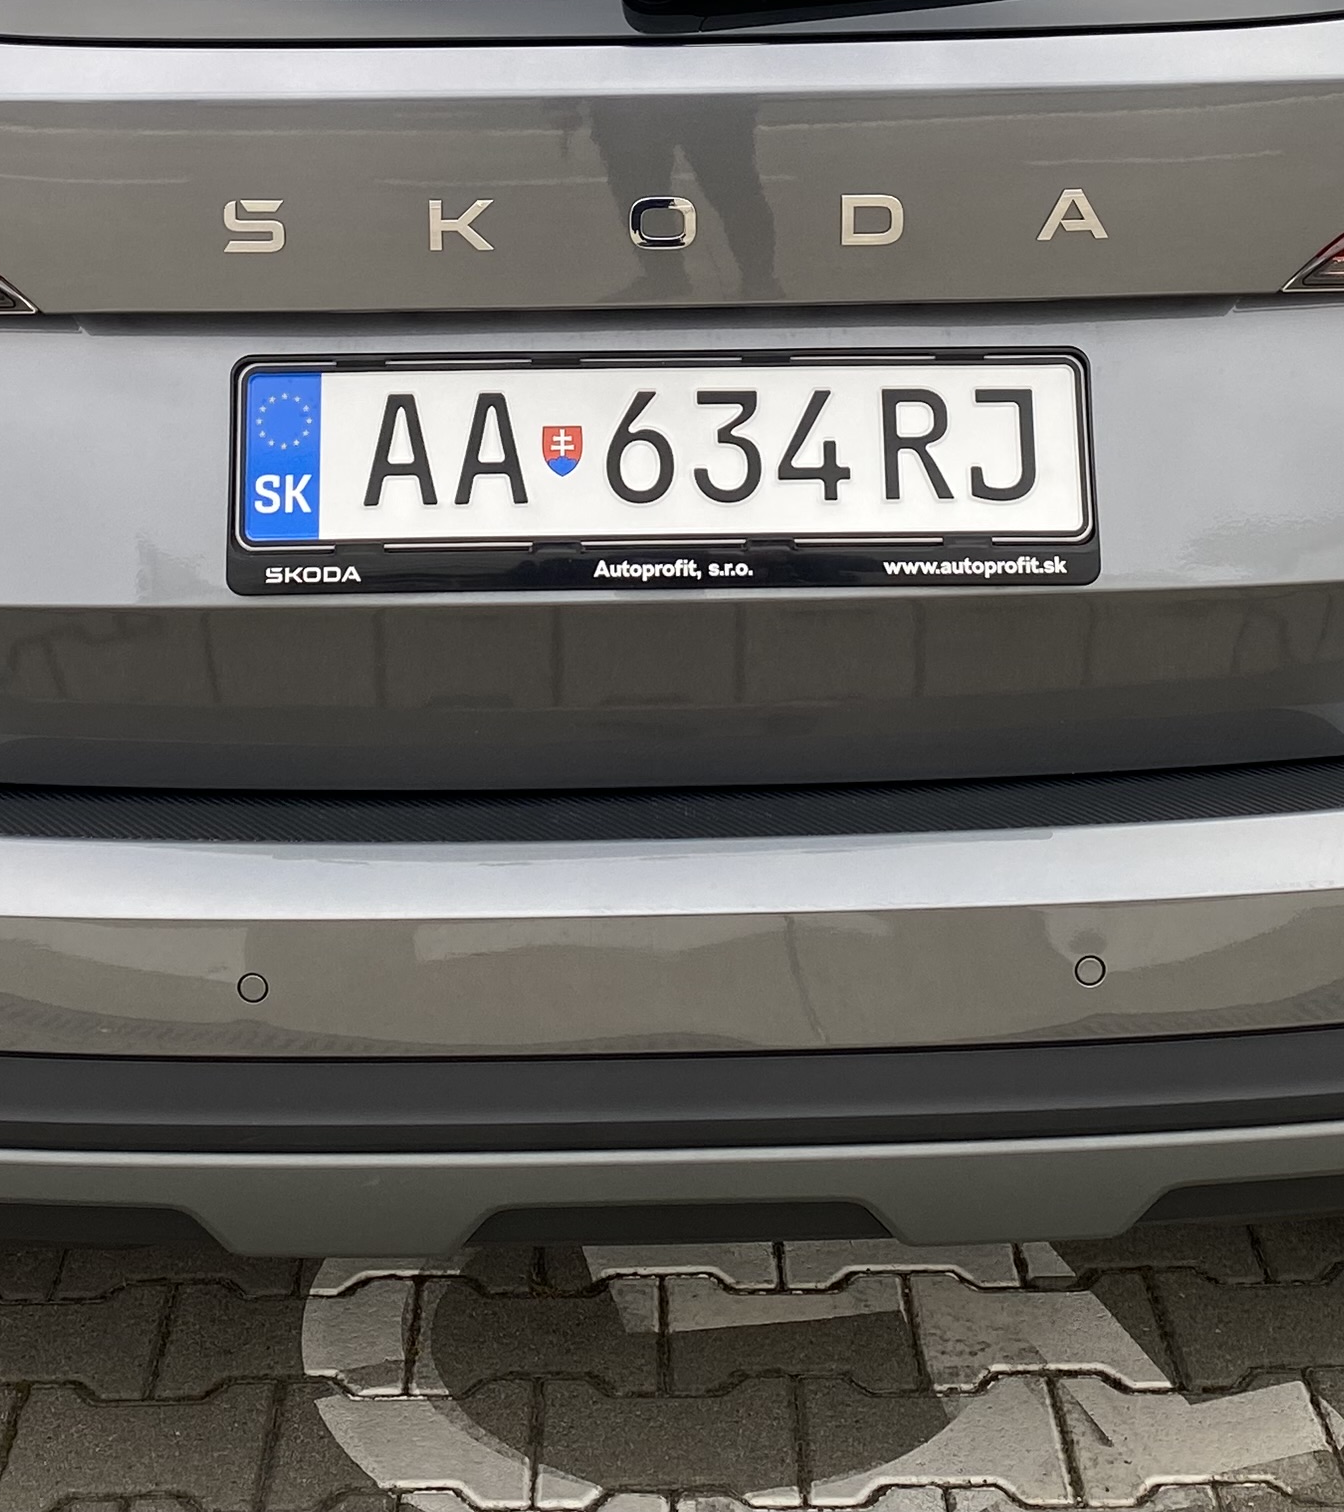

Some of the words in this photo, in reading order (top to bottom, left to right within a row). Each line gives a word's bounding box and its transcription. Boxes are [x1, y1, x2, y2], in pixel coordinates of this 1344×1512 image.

[362, 391, 529, 507] AA
[605, 387, 1037, 505] 634RJ
[253, 473, 312, 514] SK
[592, 558, 703, 581] Autoprofit,
[708, 561, 754, 577] s.r.o.
[882, 555, 1068, 578] www.autoprofit.sk
